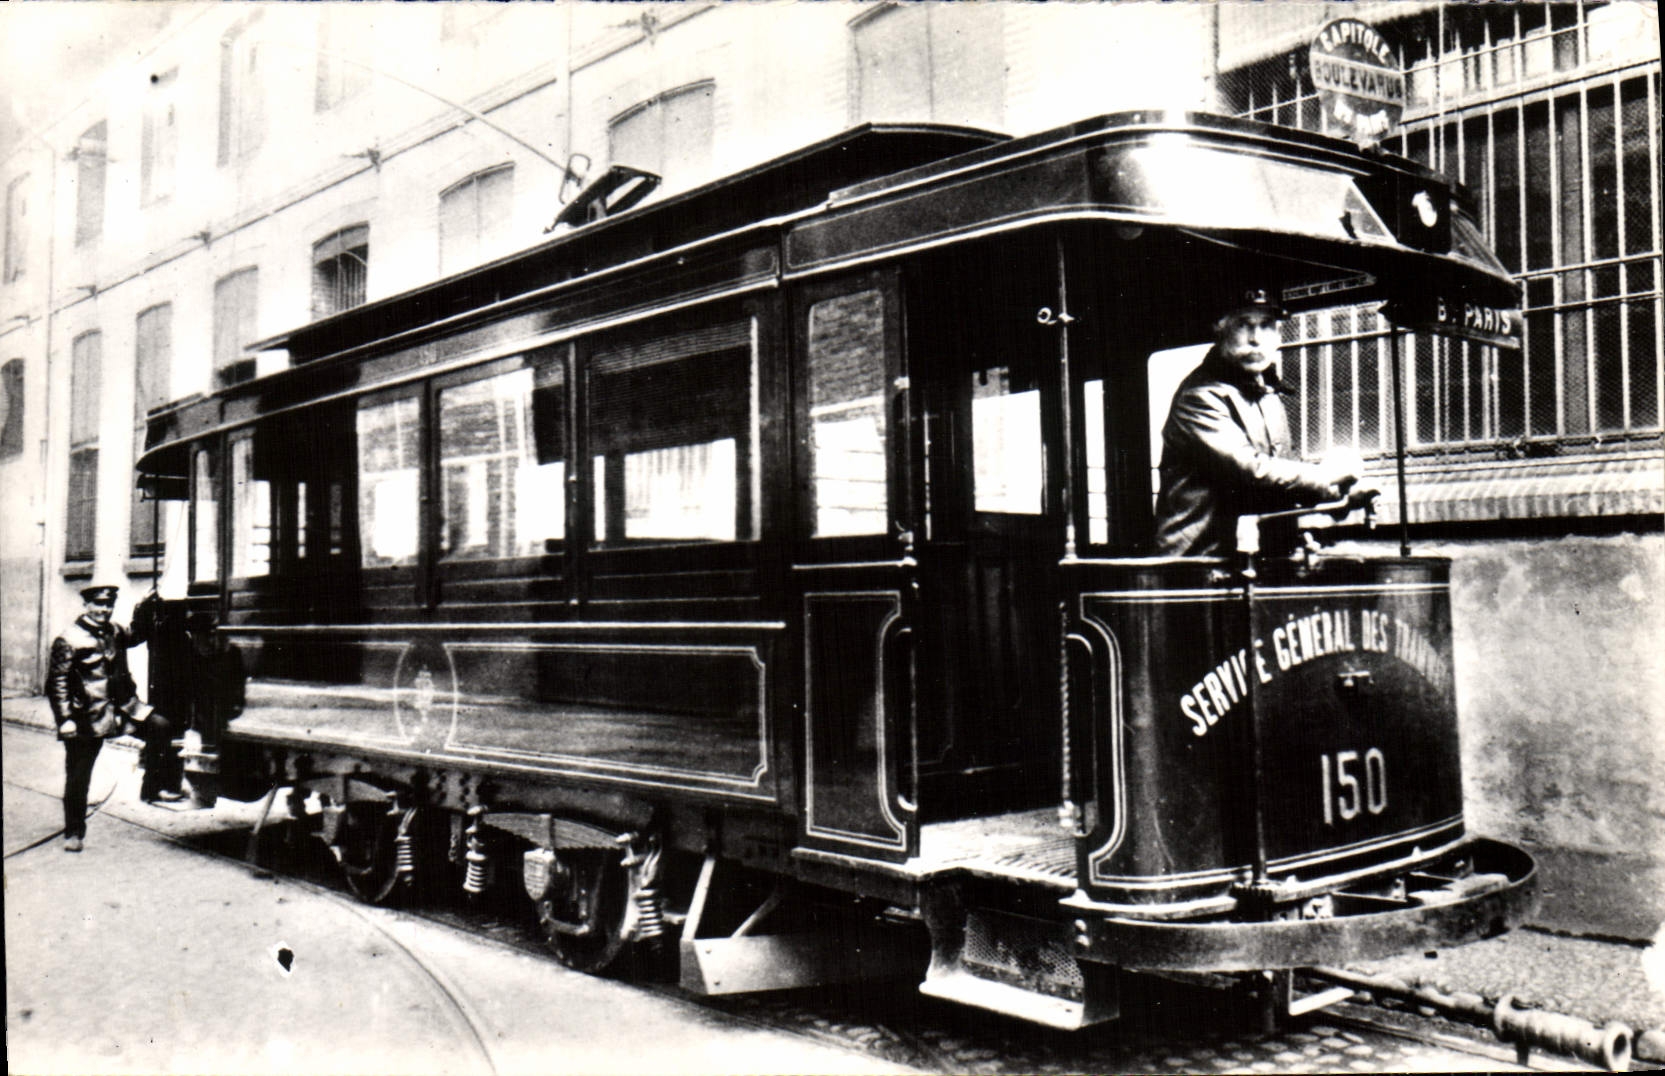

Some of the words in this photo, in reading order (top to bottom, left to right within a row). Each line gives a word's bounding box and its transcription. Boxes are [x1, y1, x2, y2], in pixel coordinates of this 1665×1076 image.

[1320, 22, 1391, 64] CAPITOLE
[1464, 302, 1511, 335] PARIS
[1272, 606, 1356, 671] GÉNÉRAL
[1361, 609, 1389, 653] DES
[1321, 747, 1387, 825] 150
